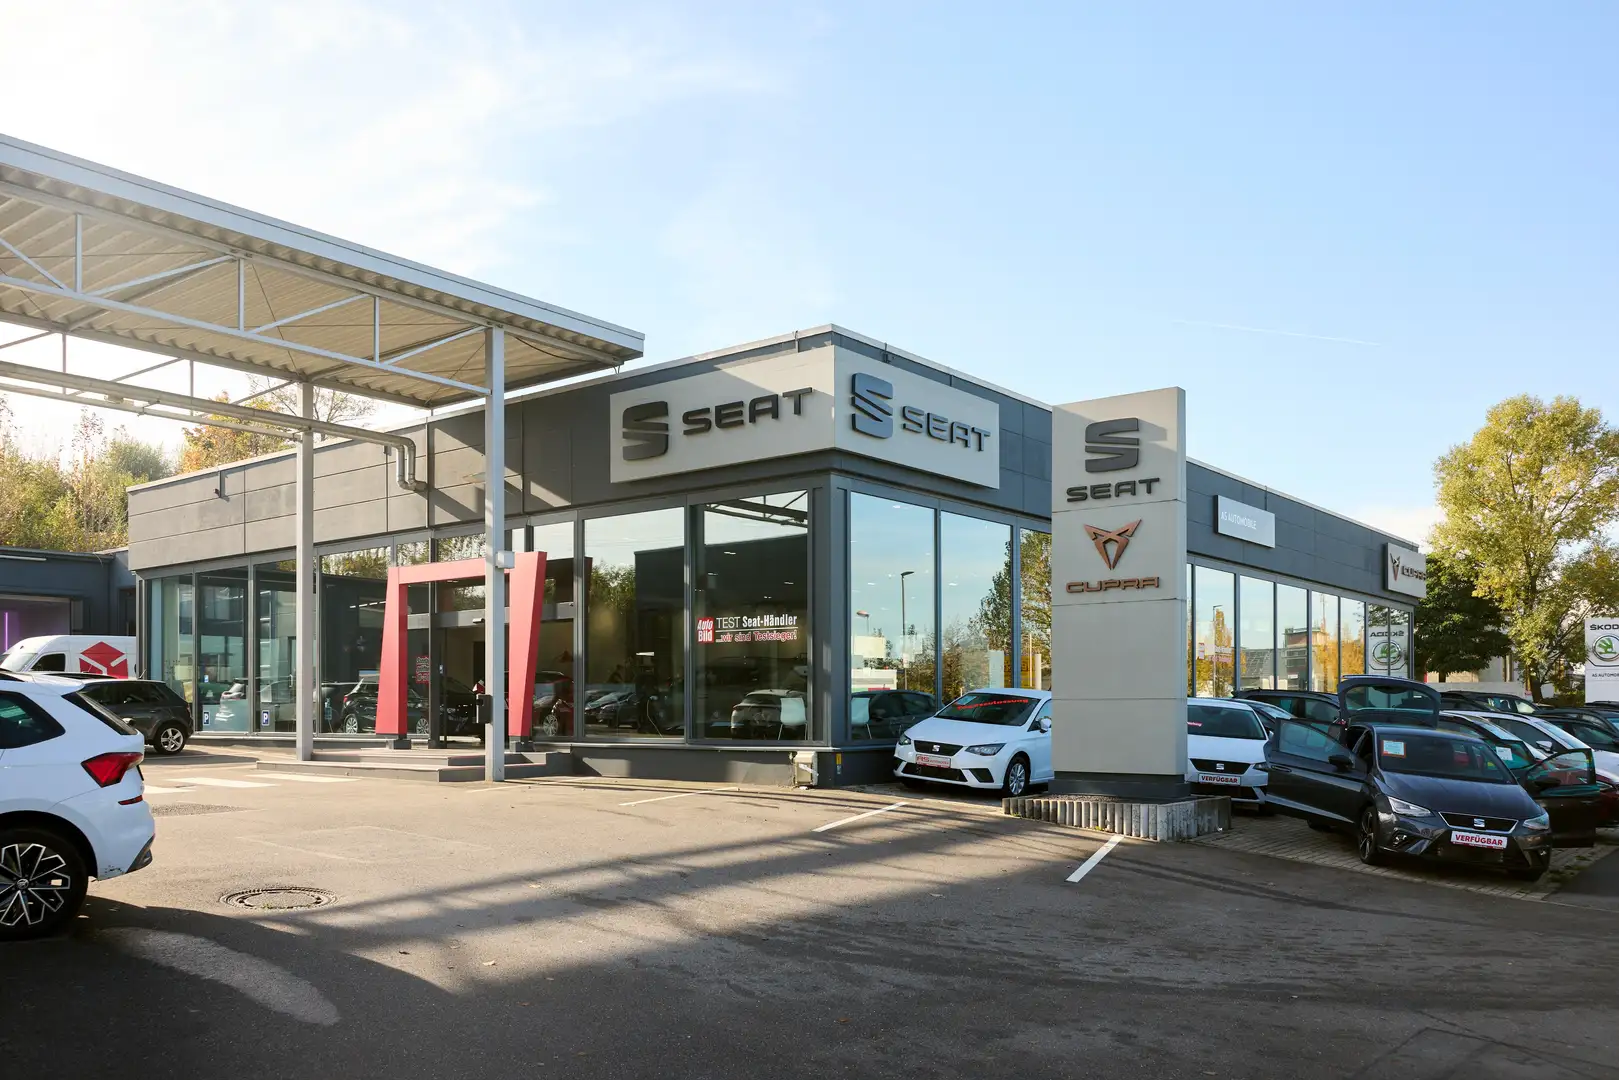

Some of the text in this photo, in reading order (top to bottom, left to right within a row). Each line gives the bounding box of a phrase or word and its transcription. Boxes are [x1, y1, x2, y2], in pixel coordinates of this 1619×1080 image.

[682, 387, 812, 435] SEAT
[903, 406, 991, 452] SEAT
[1066, 477, 1160, 502] SEAT
[1066, 576, 1159, 593] CUPRA
[697, 618, 714, 630] Auto
[716, 614, 798, 629] TEST Seat-Händler
[698, 629, 713, 642] Bild
[734, 631, 752, 642] sind
[753, 629, 798, 643] Testsieger!
[1201, 775, 1238, 783] VERFÜGBAR
[1455, 834, 1503, 846] VERFÜGBAR
